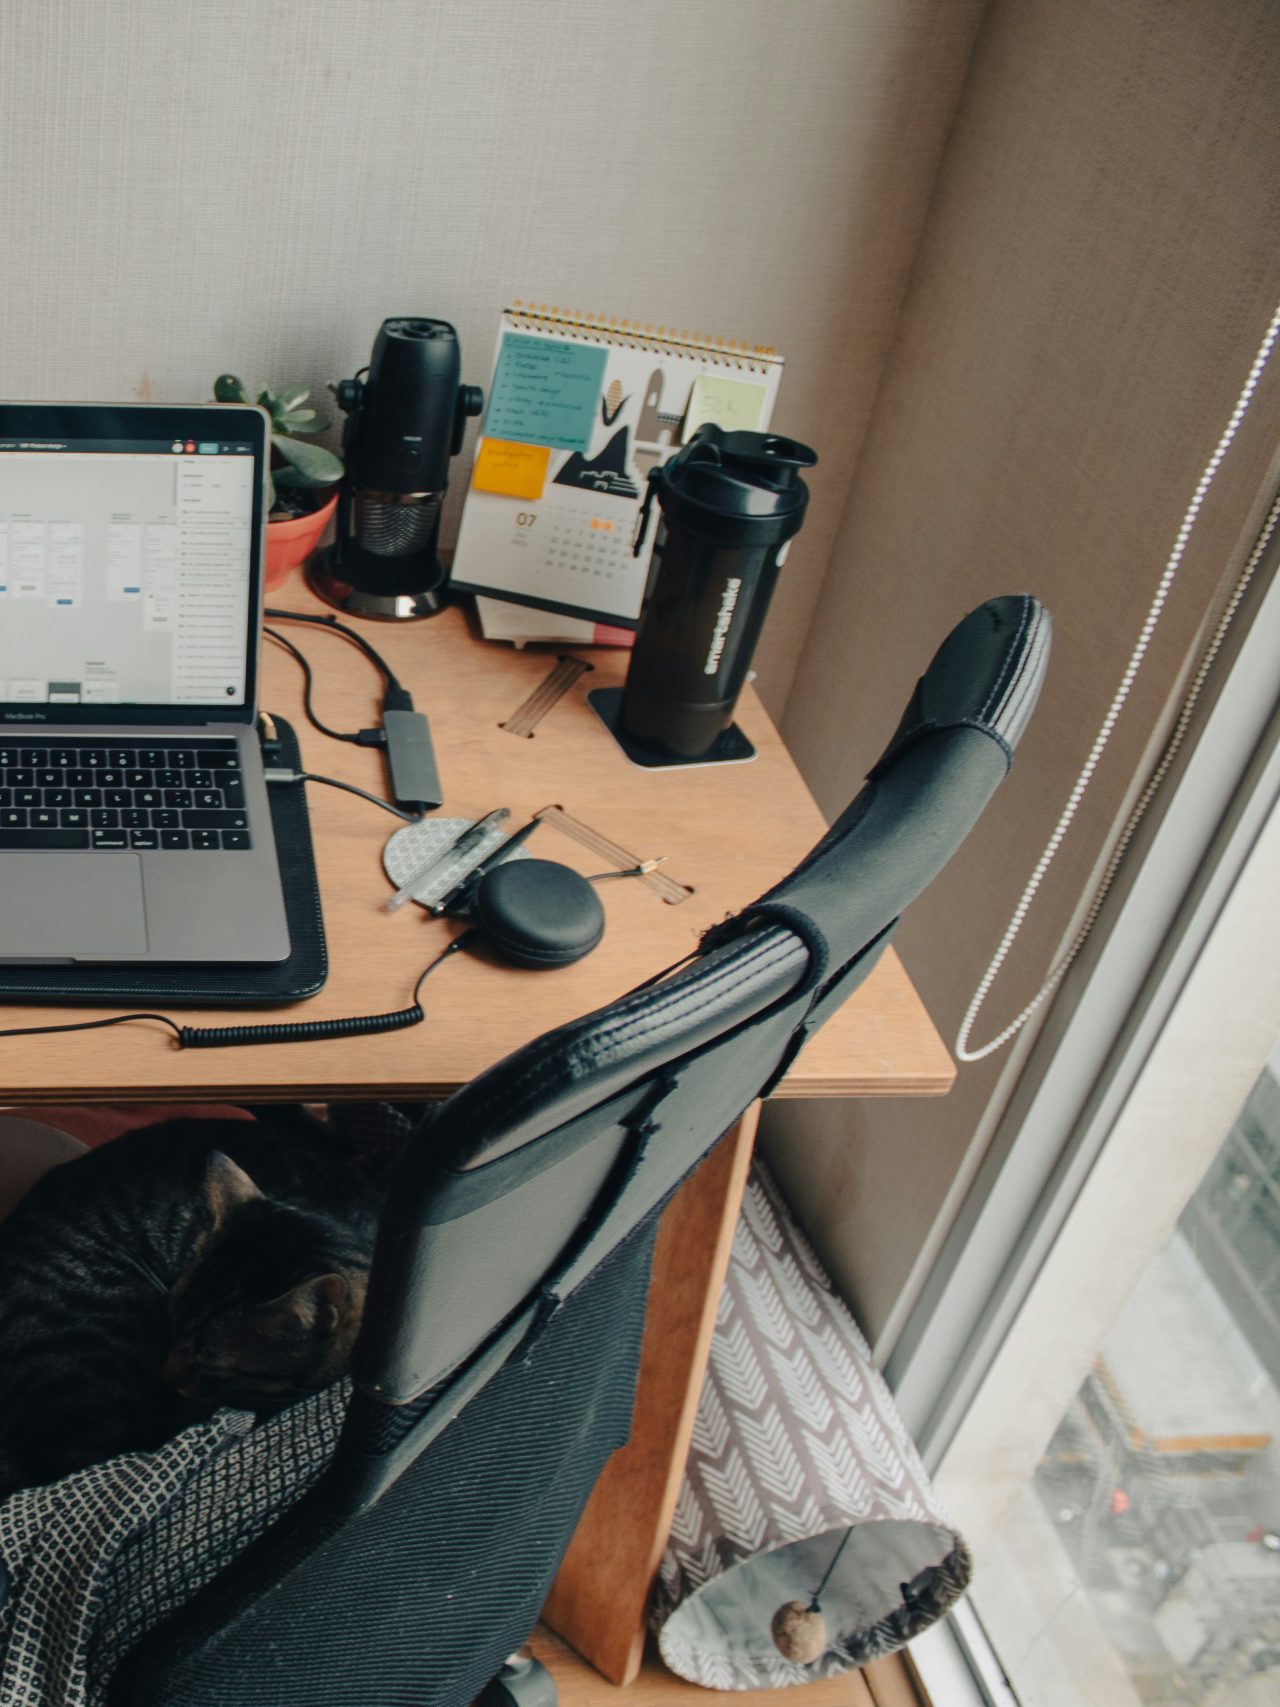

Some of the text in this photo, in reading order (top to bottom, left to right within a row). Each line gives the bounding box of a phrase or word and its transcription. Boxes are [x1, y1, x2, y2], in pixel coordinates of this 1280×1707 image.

[516, 512, 536, 528] 07
[704, 578, 742, 674] smartshake
[4, 712, 47, 720] MacBook Pro
